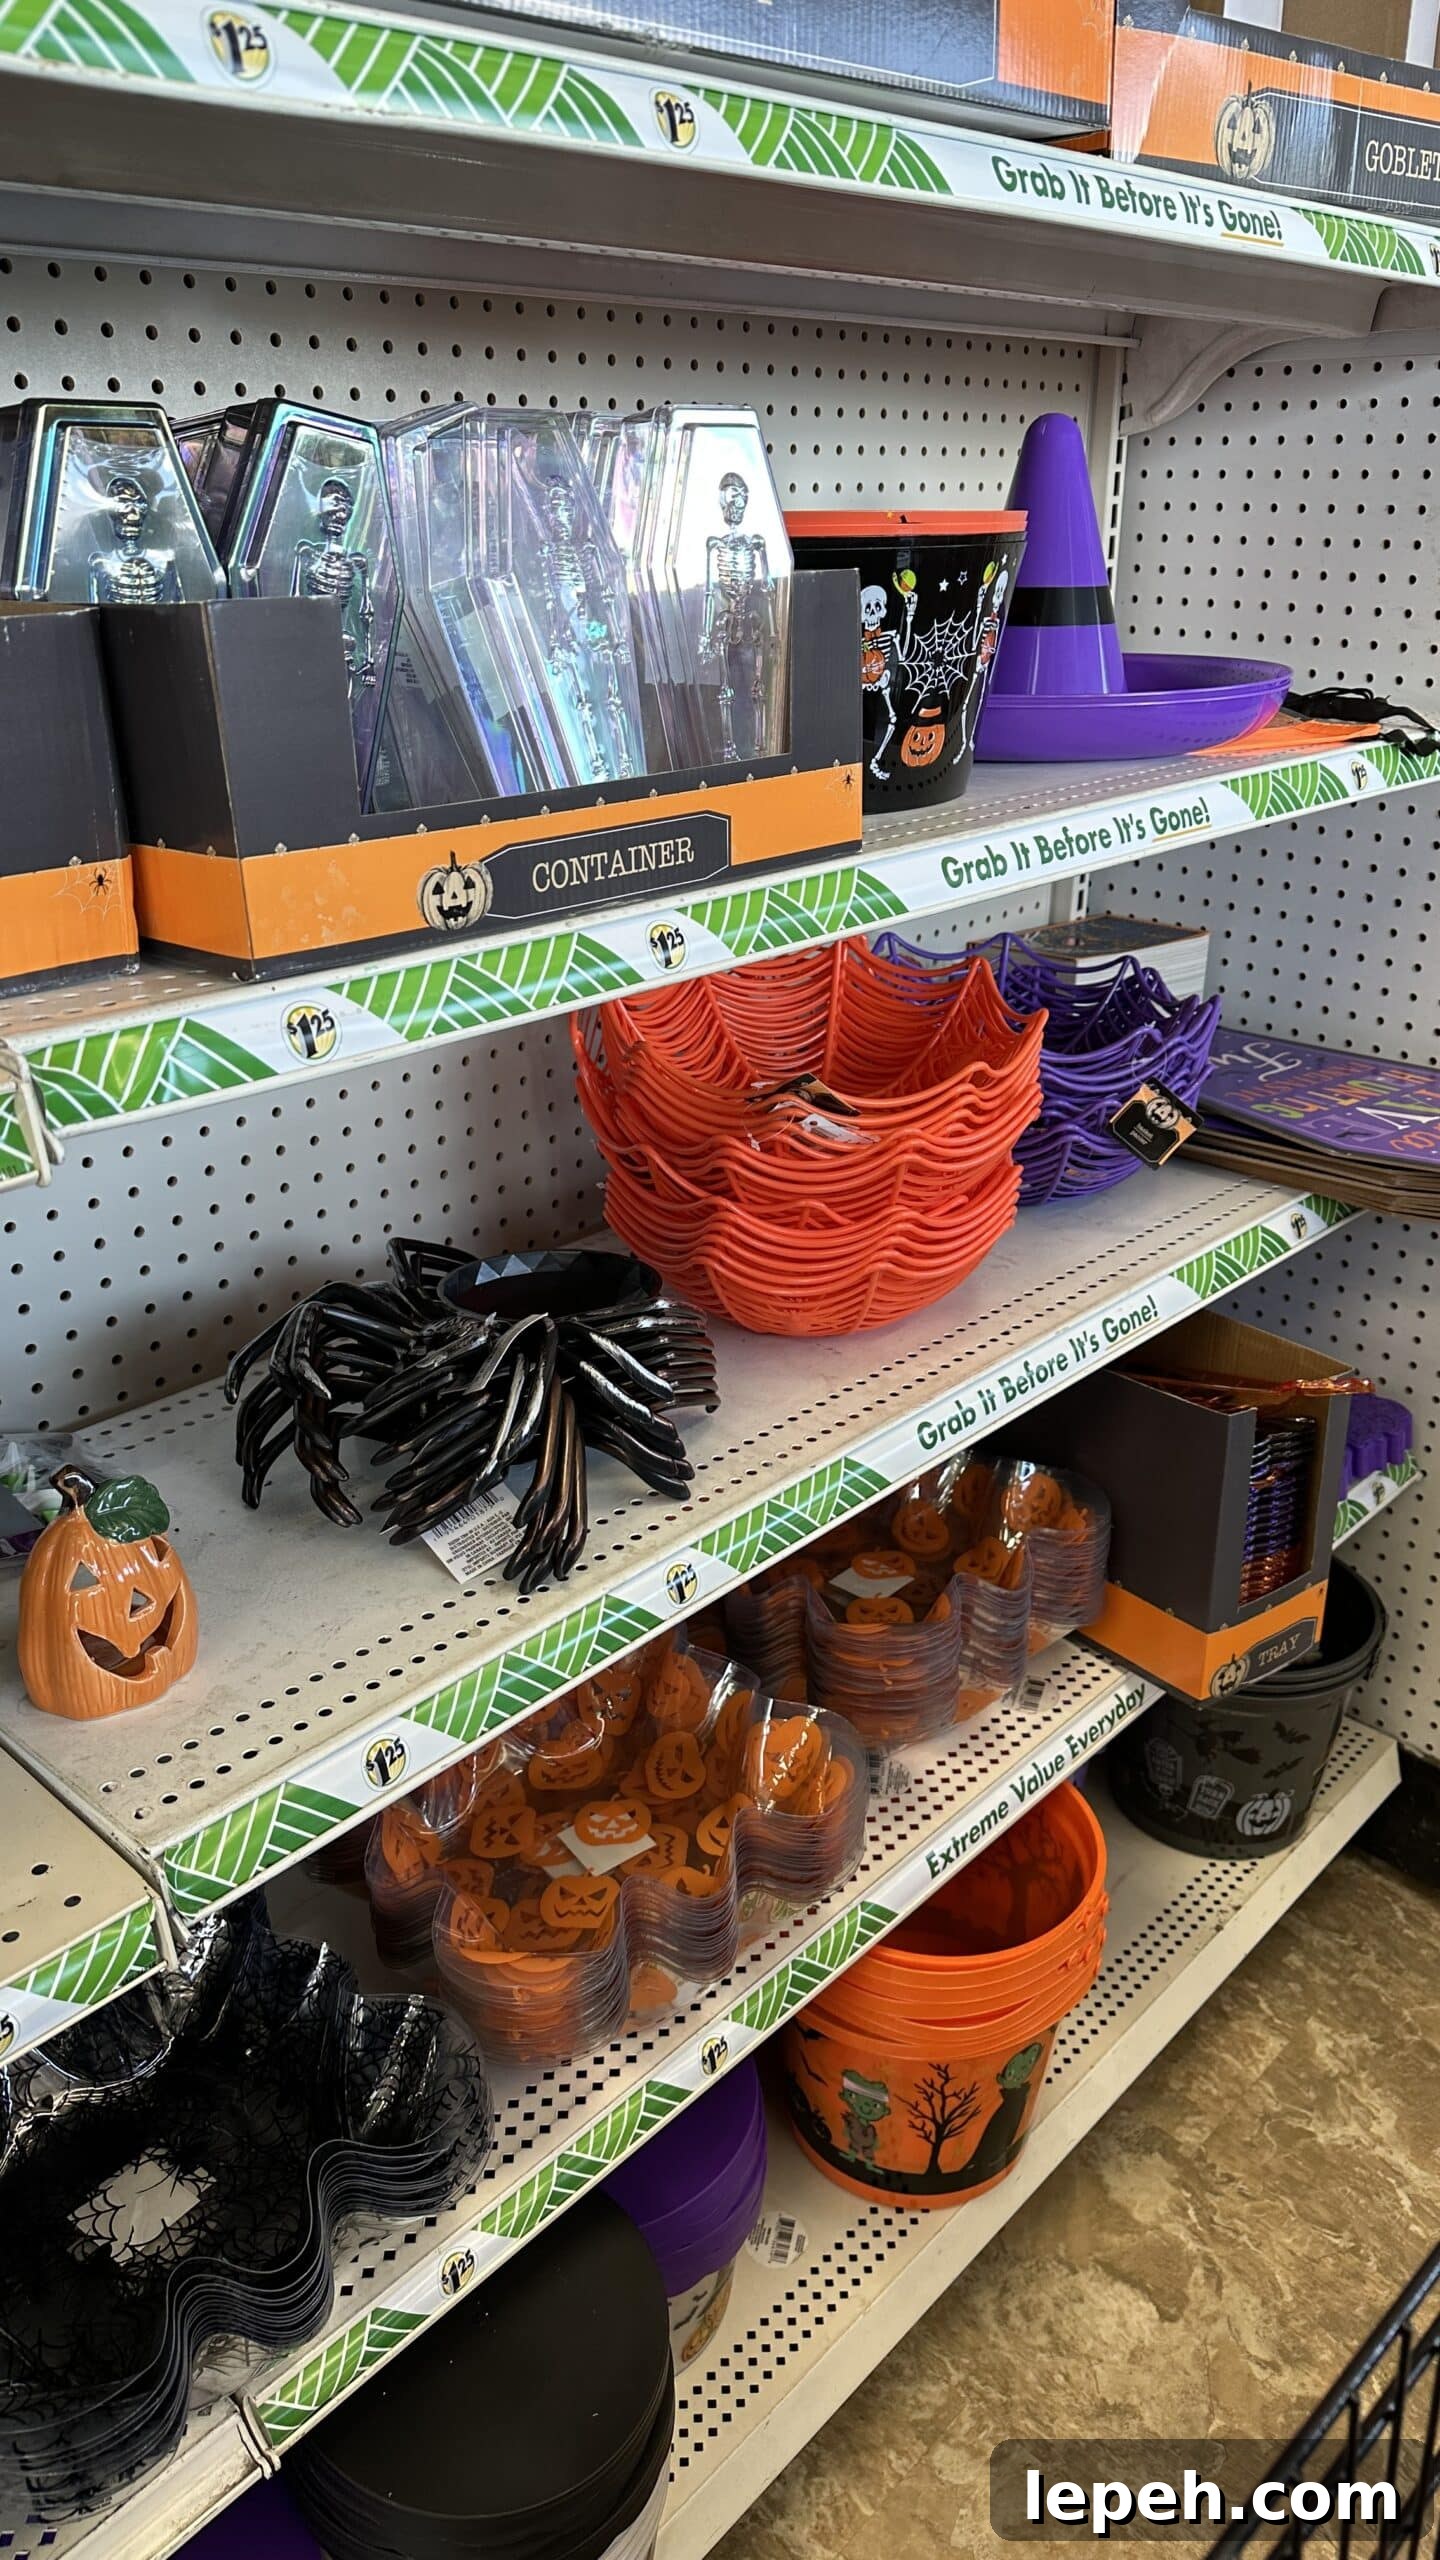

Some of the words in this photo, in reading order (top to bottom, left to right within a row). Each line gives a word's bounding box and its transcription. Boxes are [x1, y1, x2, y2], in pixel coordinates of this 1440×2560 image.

[992, 156, 1065, 200] Grab
[1069, 170, 1090, 205] It
[1094, 175, 1177, 221] Before
[1180, 191, 1214, 227] It's
[1218, 200, 1283, 240] Gone!
[532, 836, 694, 893] CONTAINER
[941, 845, 1008, 889] Grab
[1010, 841, 1030, 871] It
[1033, 826, 1112, 865] Before
[1112, 813, 1147, 844] It's
[1149, 796, 1210, 835] Gone!
[917, 1400, 976, 1450] Grab
[977, 1388, 997, 1416] It
[998, 1360, 1069, 1403] Before
[1069, 1330, 1100, 1362] It's
[1101, 1294, 1159, 1343] Gone!
[1258, 1632, 1301, 1667] TRAY
[925, 1800, 1009, 1879] Extreme
[1010, 1754, 1065, 1803] Value
[1065, 1682, 1145, 1759] Everyday
